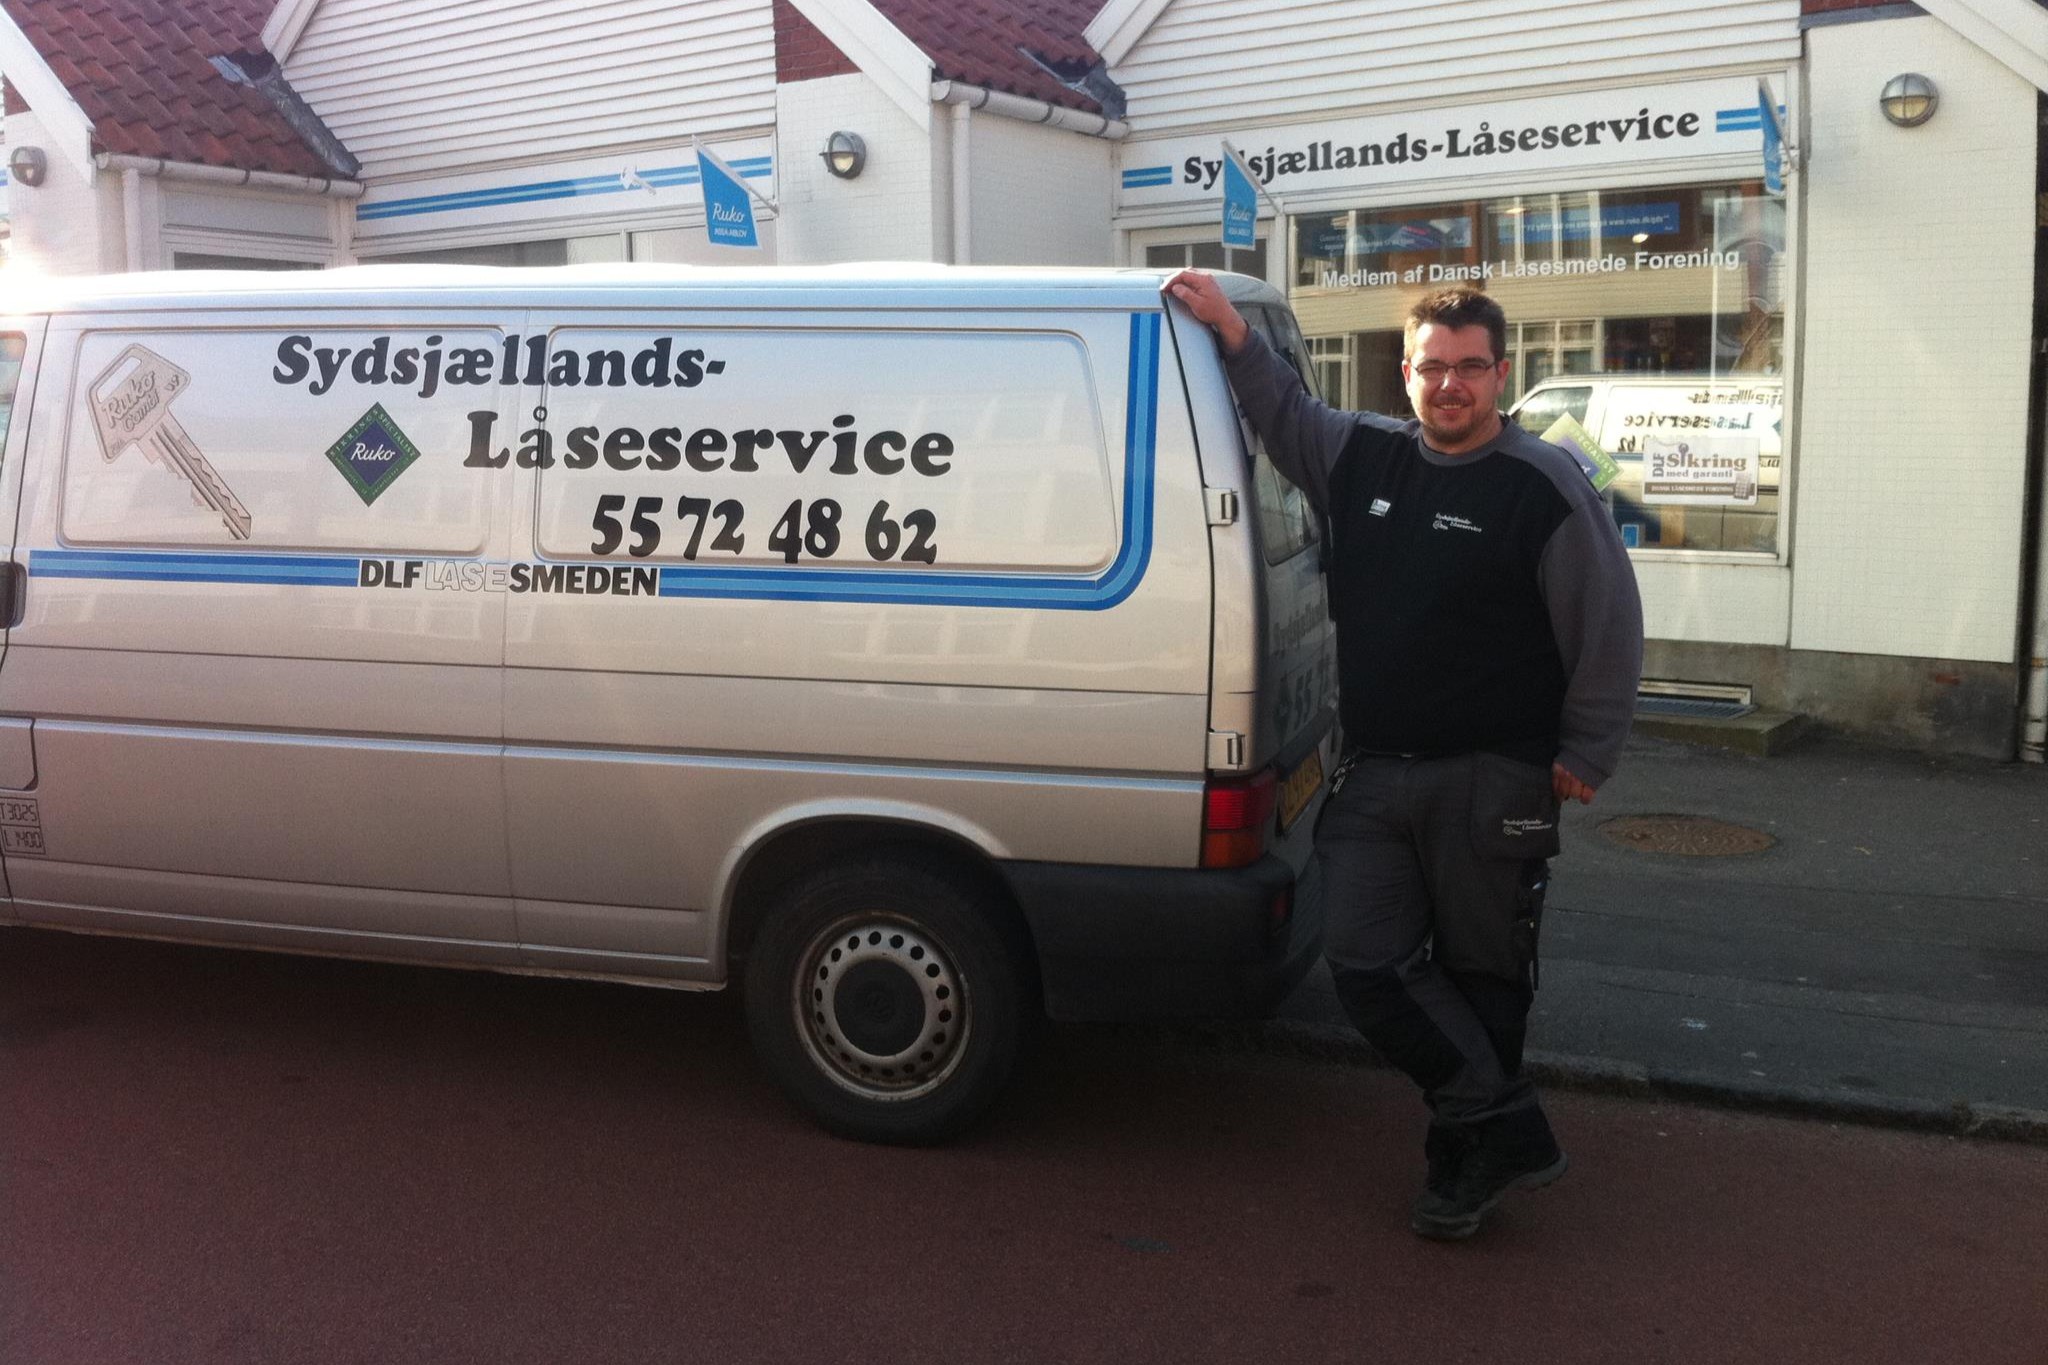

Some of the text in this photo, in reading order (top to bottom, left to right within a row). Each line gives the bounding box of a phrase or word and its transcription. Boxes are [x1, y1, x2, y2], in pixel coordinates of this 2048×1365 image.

[1184, 108, 1700, 191] Sysjællands-Låseservice
[712, 202, 744, 223] Ruko
[1322, 270, 1397, 287] Medlem
[1404, 264, 1424, 283] af
[1429, 261, 1494, 282] Dansk
[1634, 248, 1740, 271] Forening
[273, 335, 726, 398] Sydsjællands-
[350, 442, 396, 461] Ruko
[463, 406, 954, 477] Låseservice
[1666, 443, 1747, 471] Sikring
[1652, 452, 1665, 477] DLF
[1666, 469, 1733, 479] med garanti
[591, 494, 937, 564] 55 72 48 62
